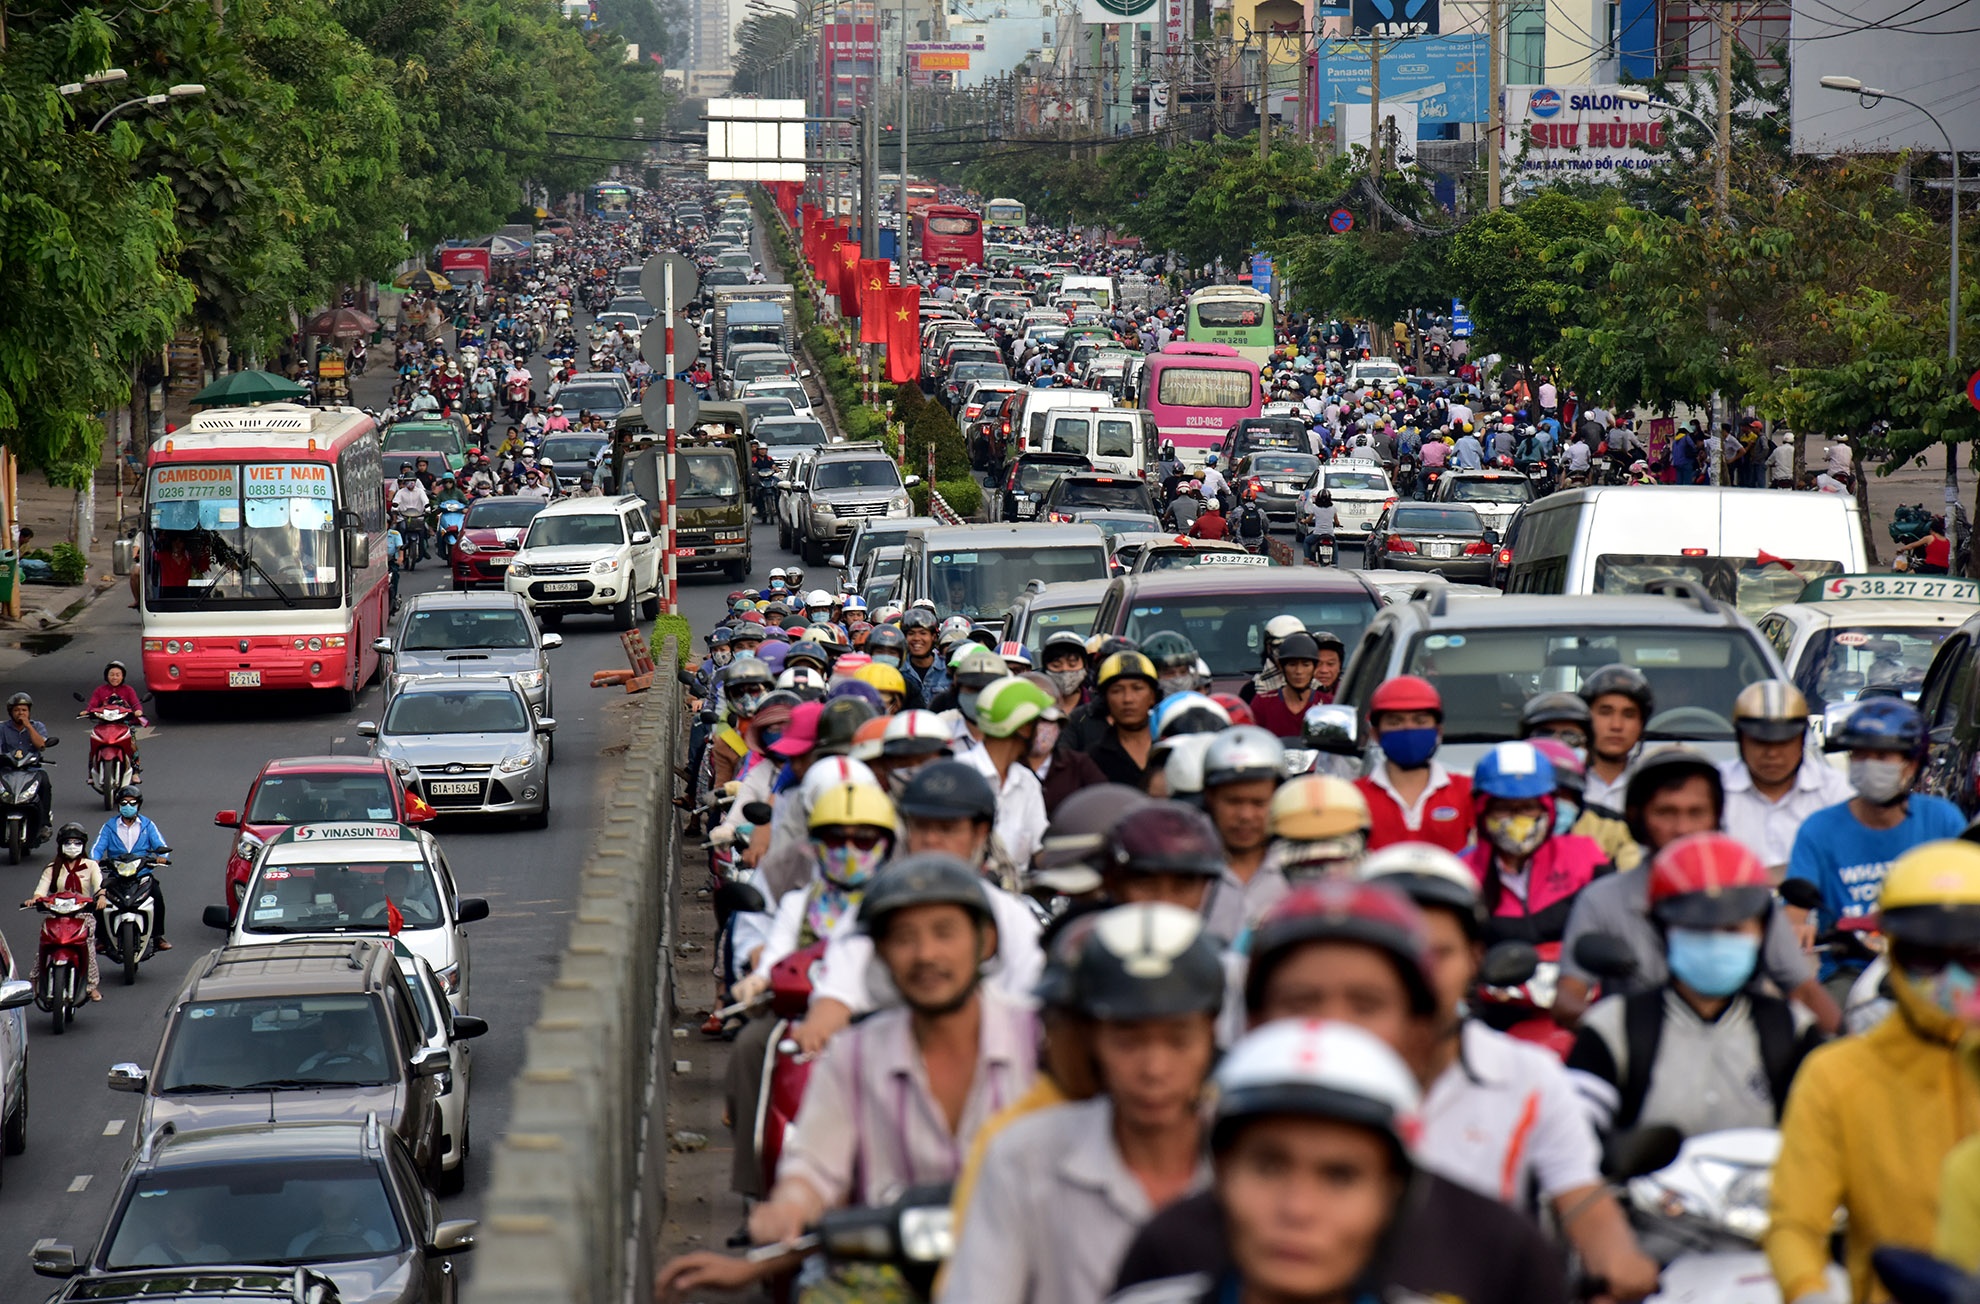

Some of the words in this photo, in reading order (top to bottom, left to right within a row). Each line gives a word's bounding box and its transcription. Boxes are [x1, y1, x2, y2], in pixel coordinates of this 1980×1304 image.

[1371, 22, 1428, 37] ANZ
[1327, 67, 1373, 77] Panasoni
[1530, 123, 1579, 149] SIU
[1587, 116, 1667, 149] HÙNG
[1568, 160, 1593, 170] TRAO
[1595, 155, 1613, 170] ĐỔI
[1615, 158, 1634, 169] CÁC
[1186, 416, 1223, 427] 62LD-0425
[157, 468, 233, 484] CAMBODIA
[249, 467, 285, 481] VIET
[291, 467, 326, 481] NAM
[158, 486, 185, 498] 0236
[188, 486, 215, 497] 7777
[218, 485, 232, 497] 89
[249, 485, 276, 496] 0838
[279, 485, 293, 495] 54
[296, 485, 310, 495] 94
[313, 485, 326, 496] 66
[1216, 555, 1241, 563] 38.27
[1243, 556, 1255, 564] 27
[1256, 557, 1267, 565] 27
[1861, 580, 1917, 595] 38.27
[1923, 582, 1947, 597] 27
[1953, 583, 1976, 598] 27
[322, 828, 375, 838] VINASUN
[375, 827, 399, 838] TAXI
